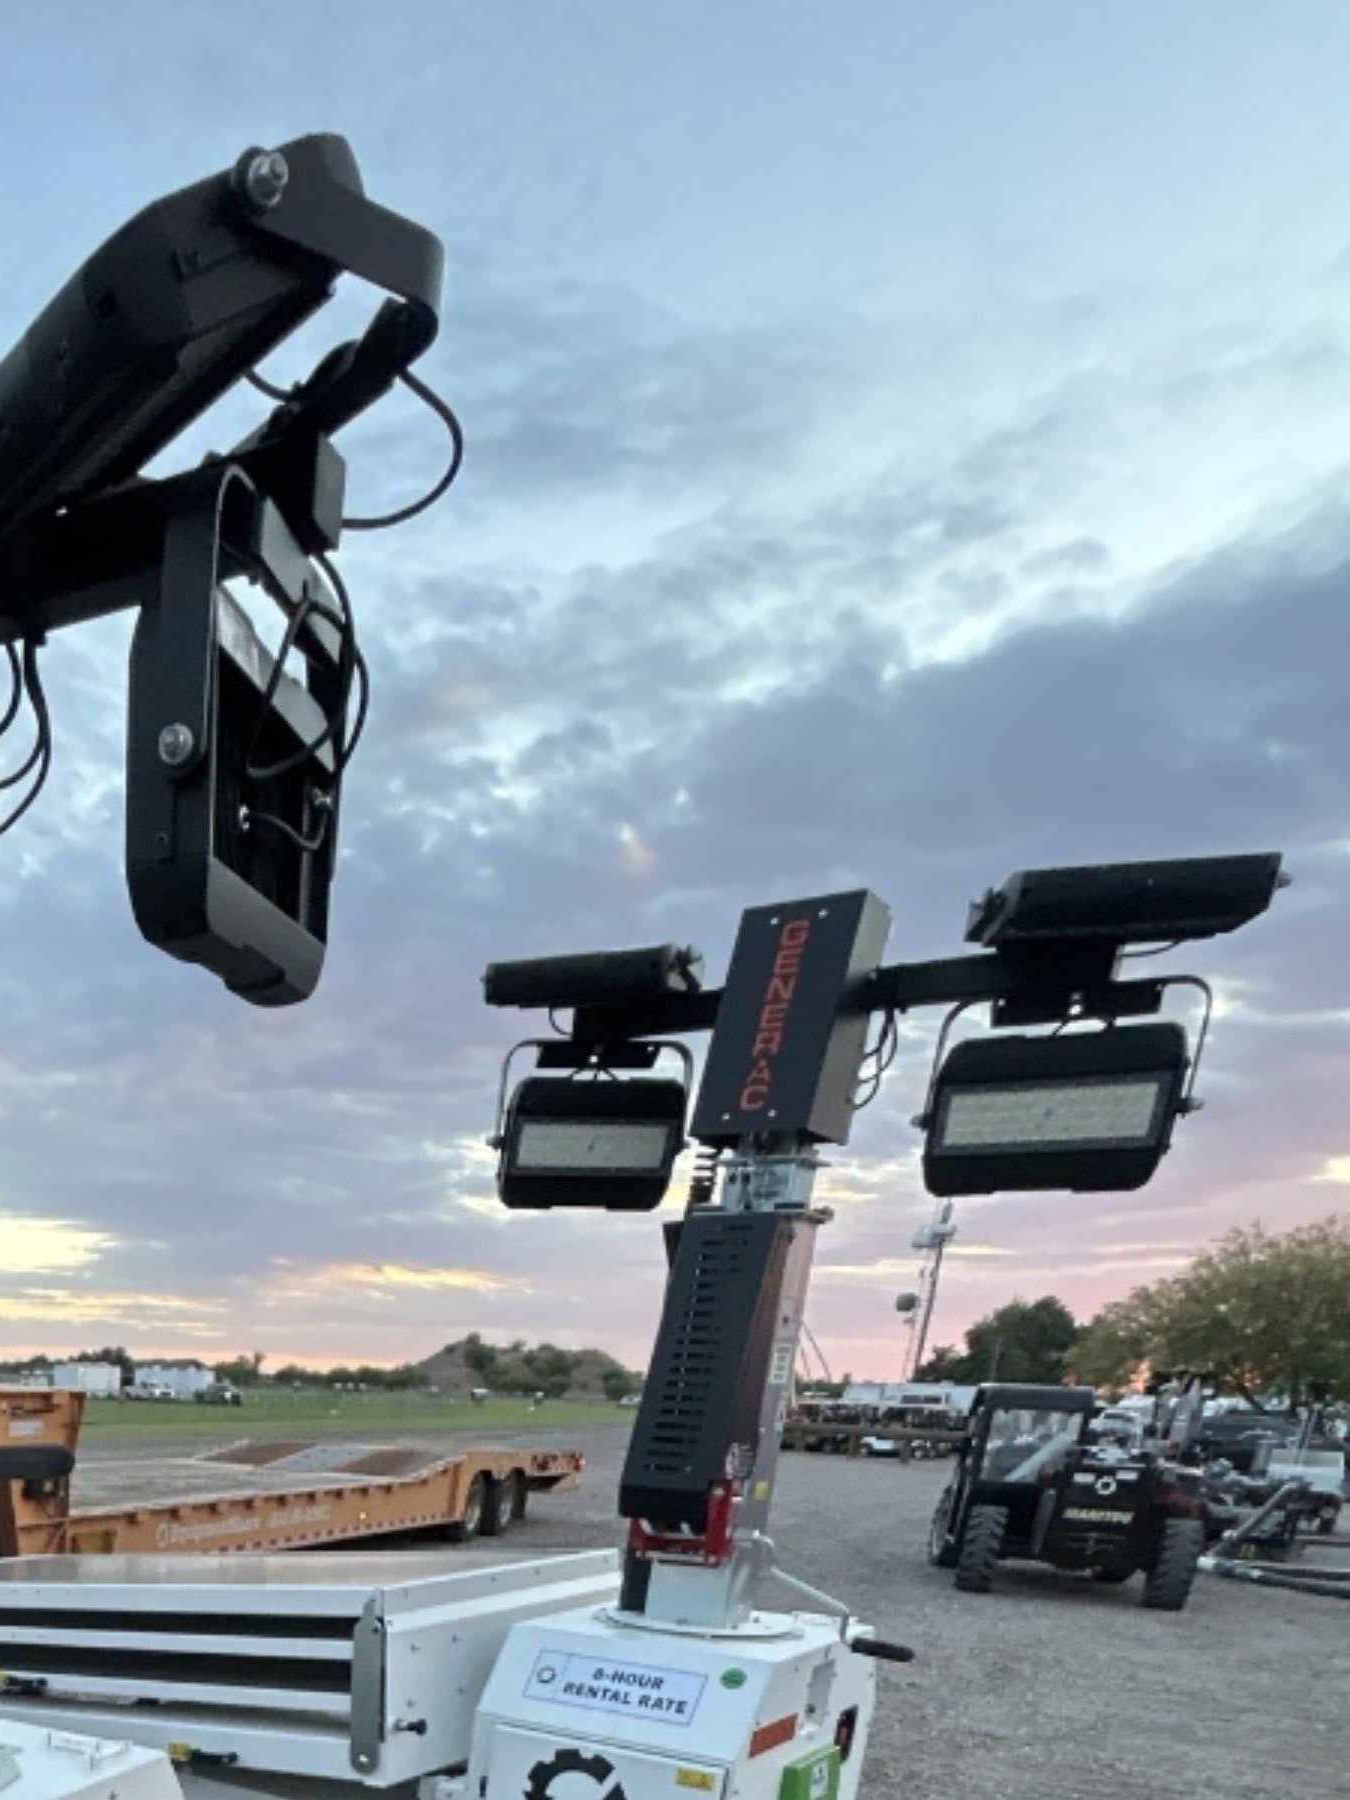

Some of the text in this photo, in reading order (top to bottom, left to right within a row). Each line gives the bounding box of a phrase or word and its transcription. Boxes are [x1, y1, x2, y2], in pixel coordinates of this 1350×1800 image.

[740, 919, 810, 1111] GENERAC
[593, 1667, 664, 1690] 8-HOUR
[563, 1682, 688, 1714] RENTAL RATE
